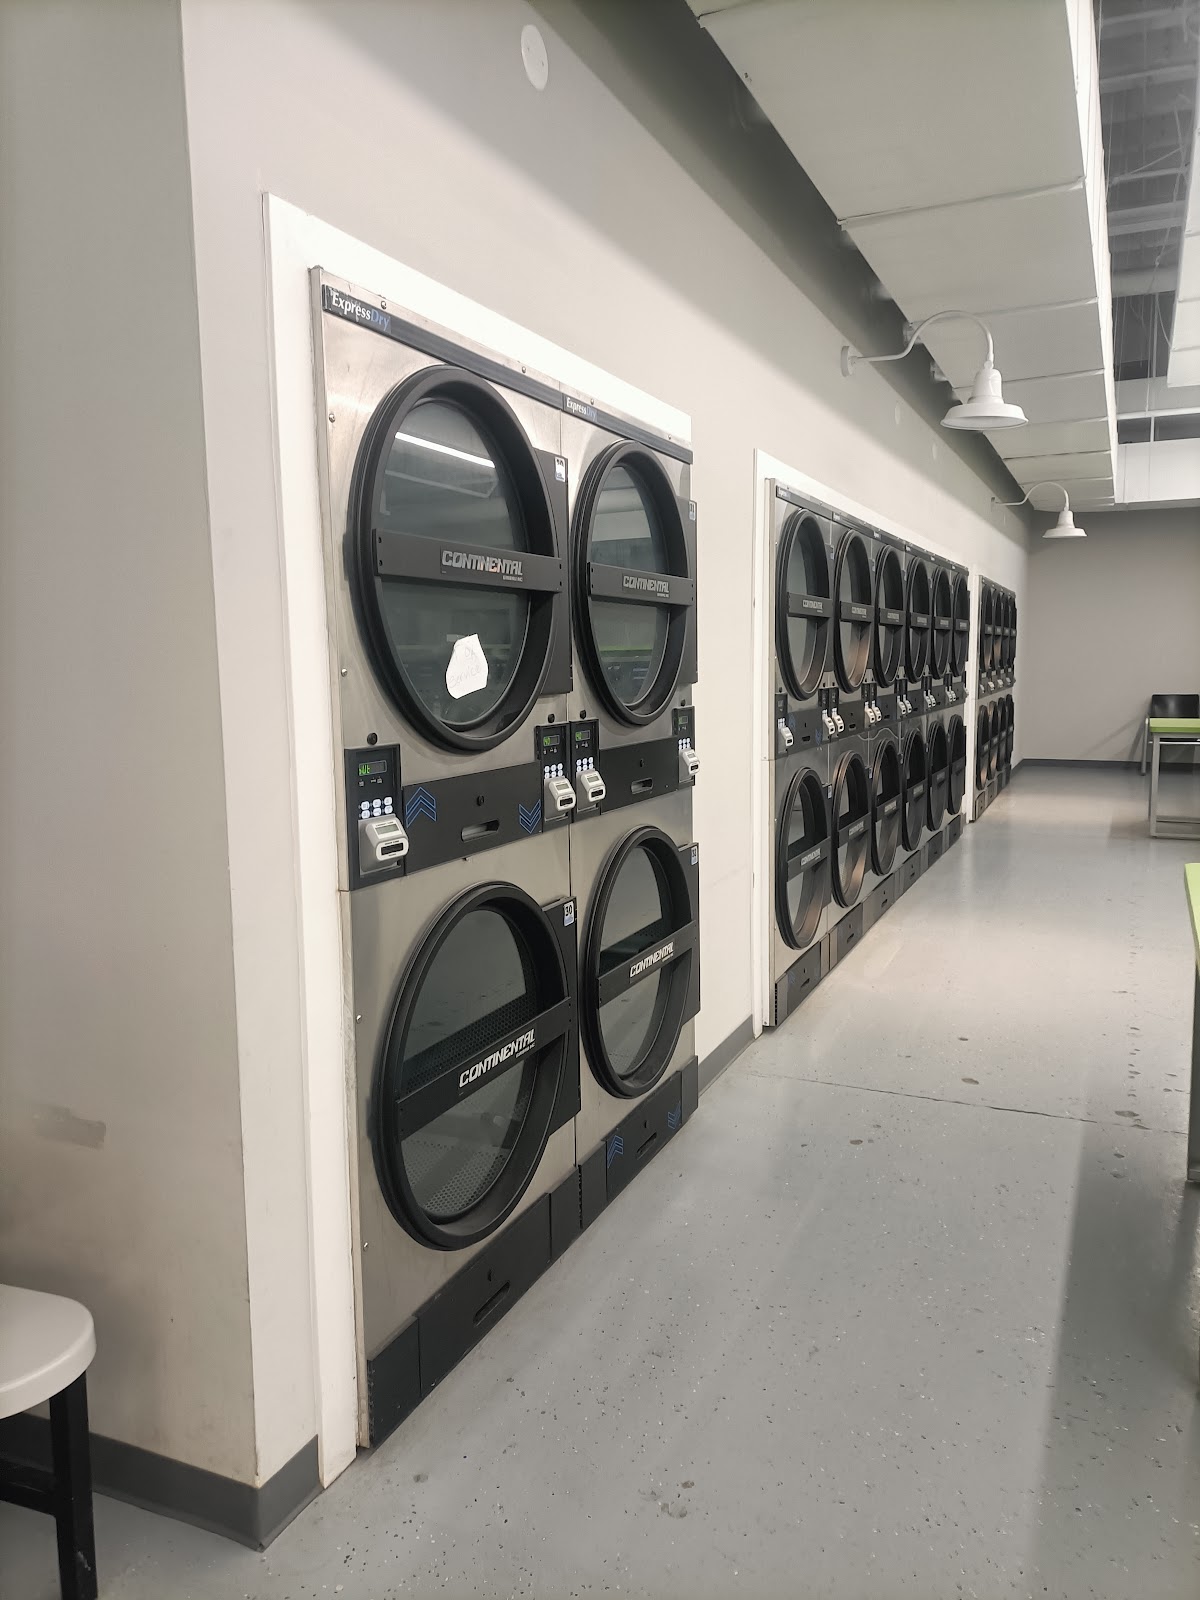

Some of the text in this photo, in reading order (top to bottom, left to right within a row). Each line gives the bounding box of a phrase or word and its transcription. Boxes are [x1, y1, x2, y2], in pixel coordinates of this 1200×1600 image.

[331, 291, 391, 331] ExpressDry
[566, 397, 598, 421] ExpressDry
[441, 550, 523, 576] CONTINENTAL
[622, 576, 669, 593] CONTINENTAL
[629, 942, 673, 978] CONTINENTAL
[459, 1029, 535, 1088] CONTINENTAL
